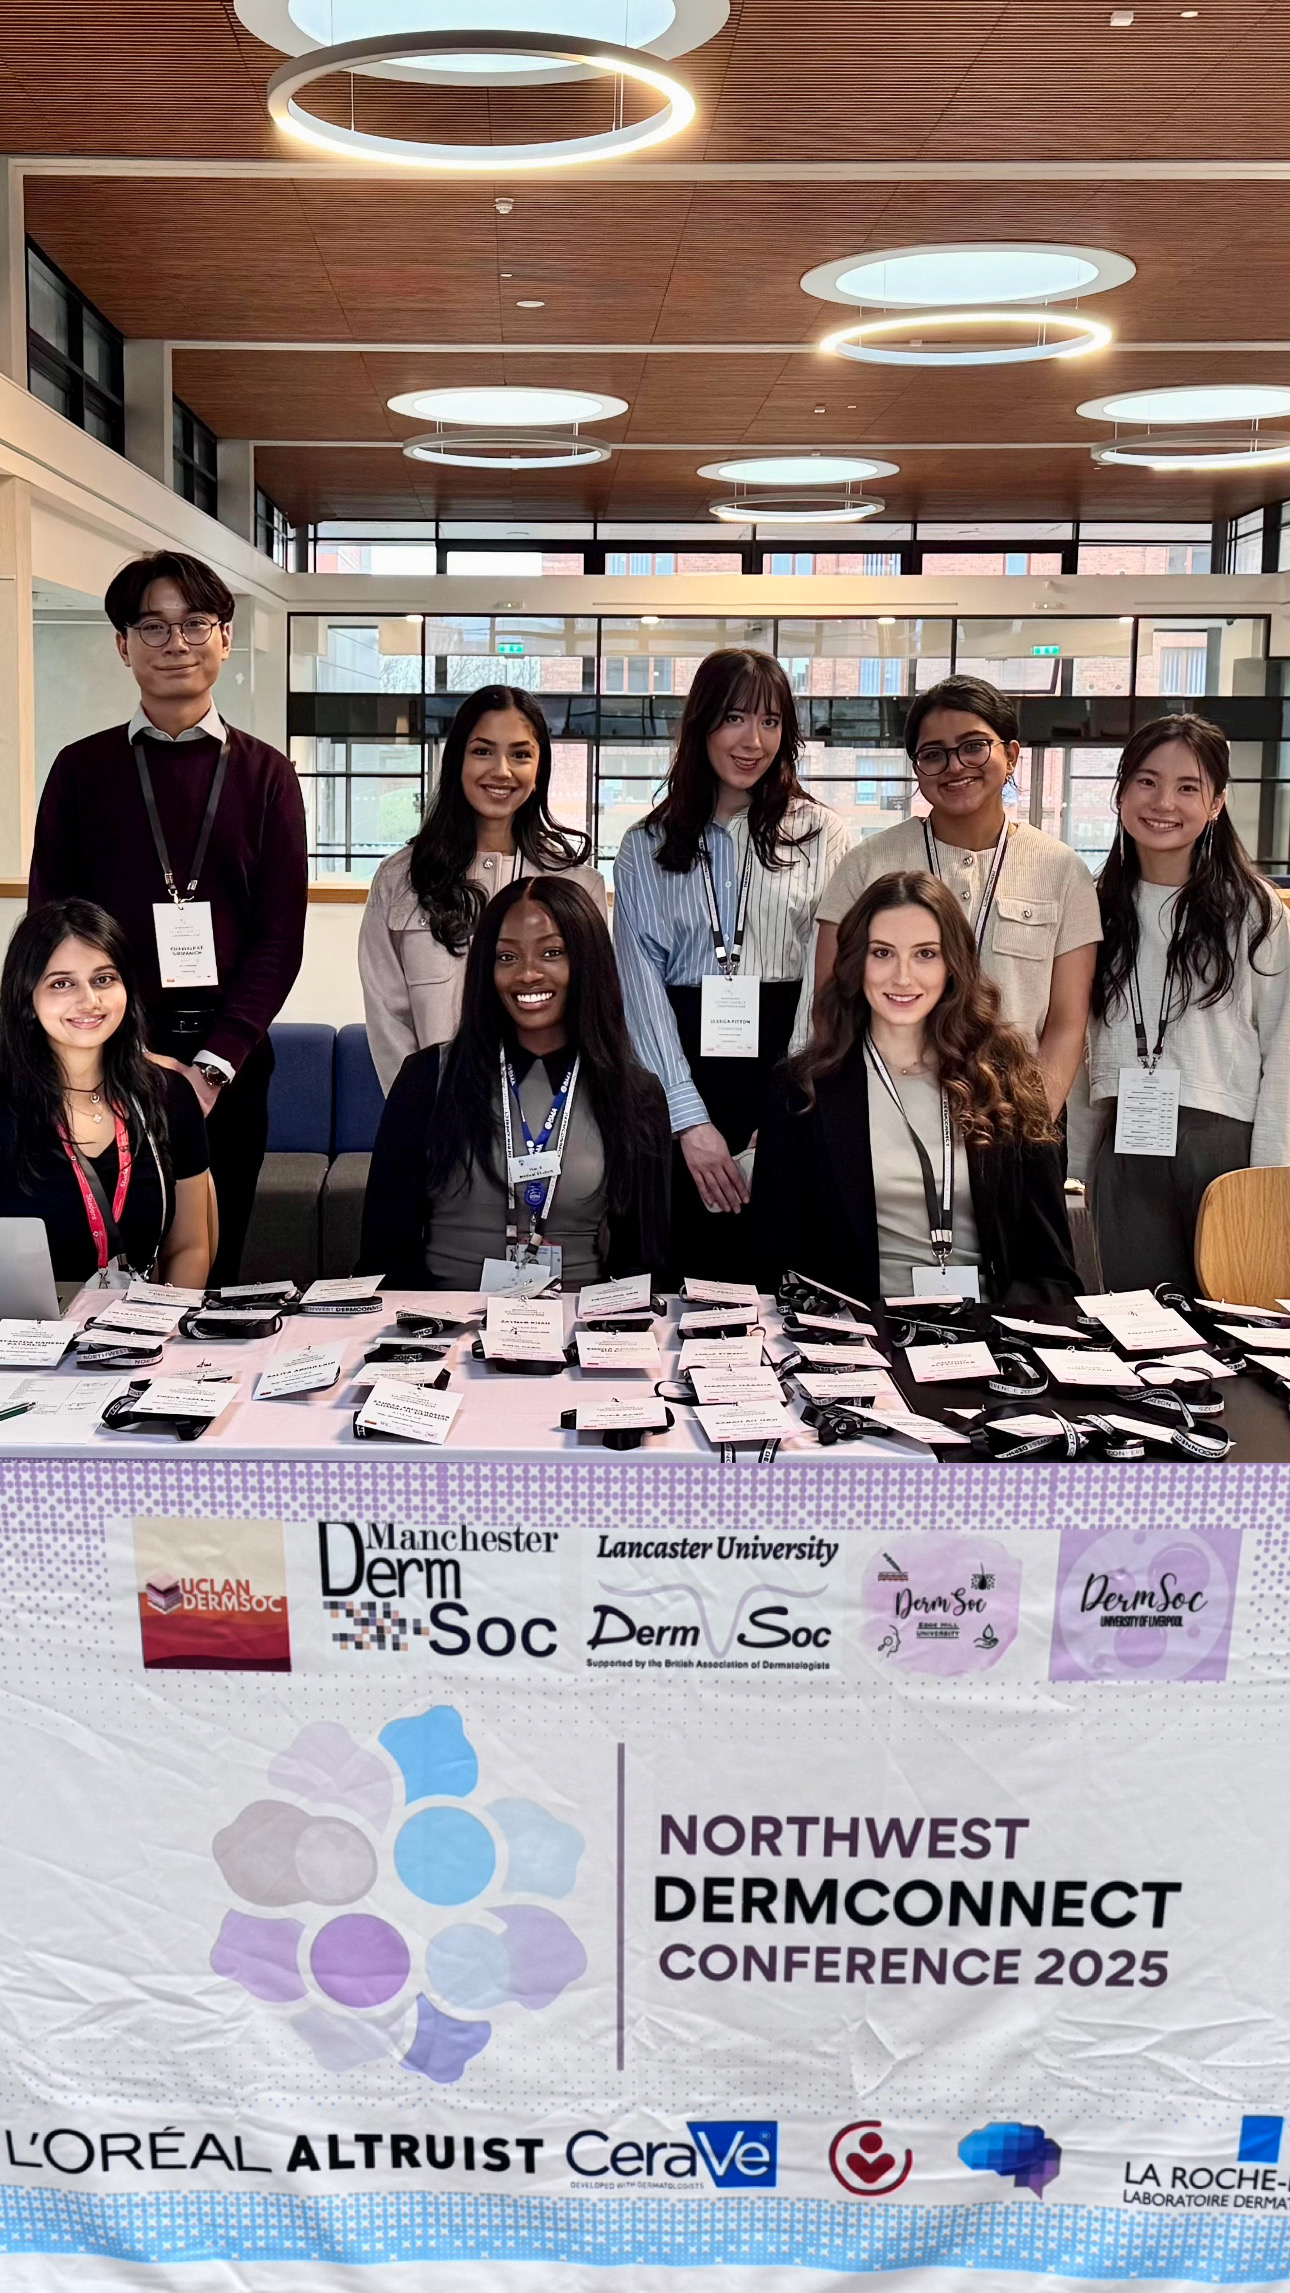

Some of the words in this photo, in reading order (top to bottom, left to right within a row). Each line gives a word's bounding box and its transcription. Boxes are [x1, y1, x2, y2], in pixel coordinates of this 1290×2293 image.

[87, 1193, 97, 1221] Student
[366, 1522, 560, 1554] Manchester
[596, 1535, 713, 1560] Lancaster
[716, 1535, 839, 1568] University
[318, 1521, 461, 1599] Derm
[181, 1578, 251, 1596] UCLAN
[182, 1594, 283, 1613] DERMSOC
[1080, 1572, 1208, 1613] DermSoc
[429, 1601, 558, 1658] Soc
[586, 1604, 700, 1651] Derm
[736, 1606, 832, 1648] Soc
[1100, 1615, 1138, 1628] UNIVERSITY
[1138, 1615, 1149, 1628] OF
[1149, 1615, 1184, 1628] LIVERPOOL
[586, 1658, 633, 1669] Supported
[635, 1658, 646, 1669] by
[648, 1659, 662, 1668] the
[664, 1659, 694, 1669] British
[696, 1660, 749, 1669] Association
[751, 1660, 760, 1669] of
[762, 1660, 830, 1671] Dermatologists
[660, 1814, 1030, 1859] NORTHWEST
[654, 1876, 1182, 1929] DERMCONNECT
[659, 1943, 1022, 1987] CONFERENCE
[1034, 1948, 1169, 1988] 2025
[5, 2127, 273, 2175] L'ORÉAL
[286, 2134, 544, 2174] ALTRUIST
[566, 2128, 771, 2178] CeraVe
[570, 2181, 615, 2190] DEVELOPED
[616, 2180, 636, 2190] WITH
[637, 2181, 705, 2191] DERMATOLOGISTS
[1125, 2161, 1161, 2188] LA
[1171, 2167, 1290, 2192] ROCHE-
[1123, 2189, 1229, 2207] LABORATOIRE
[1233, 2194, 1290, 2210] DERMA
